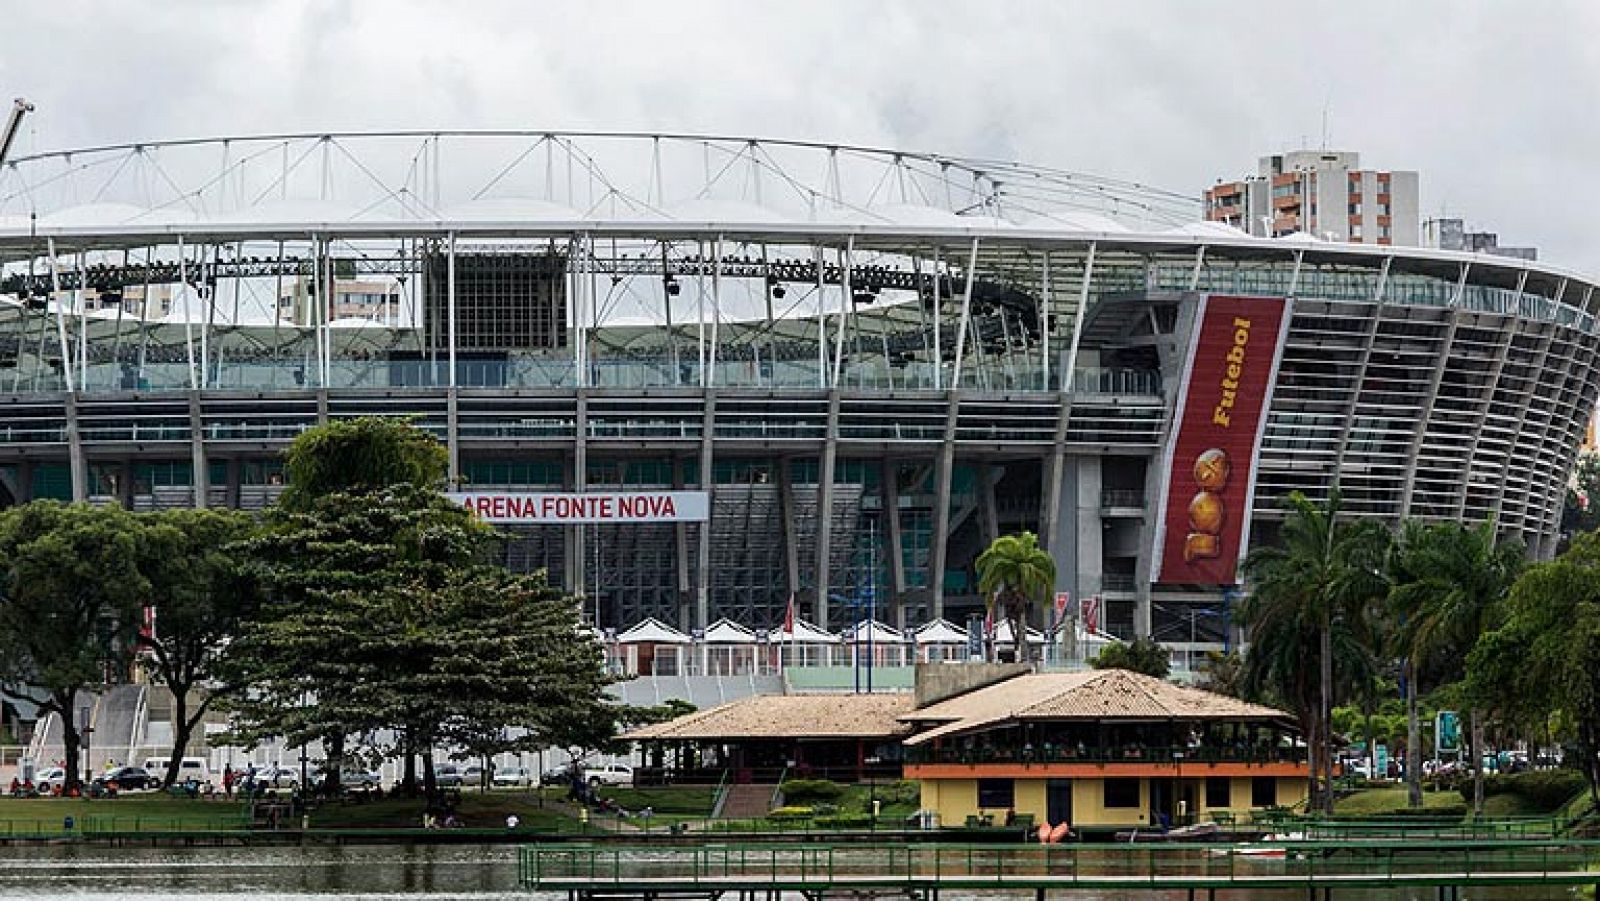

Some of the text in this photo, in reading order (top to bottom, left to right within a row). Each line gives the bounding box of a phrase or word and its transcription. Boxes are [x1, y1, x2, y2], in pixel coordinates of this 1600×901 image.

[1213, 318, 1250, 427] Futebol
[542, 496, 613, 518] FONTE
[618, 496, 676, 518] NOVA
